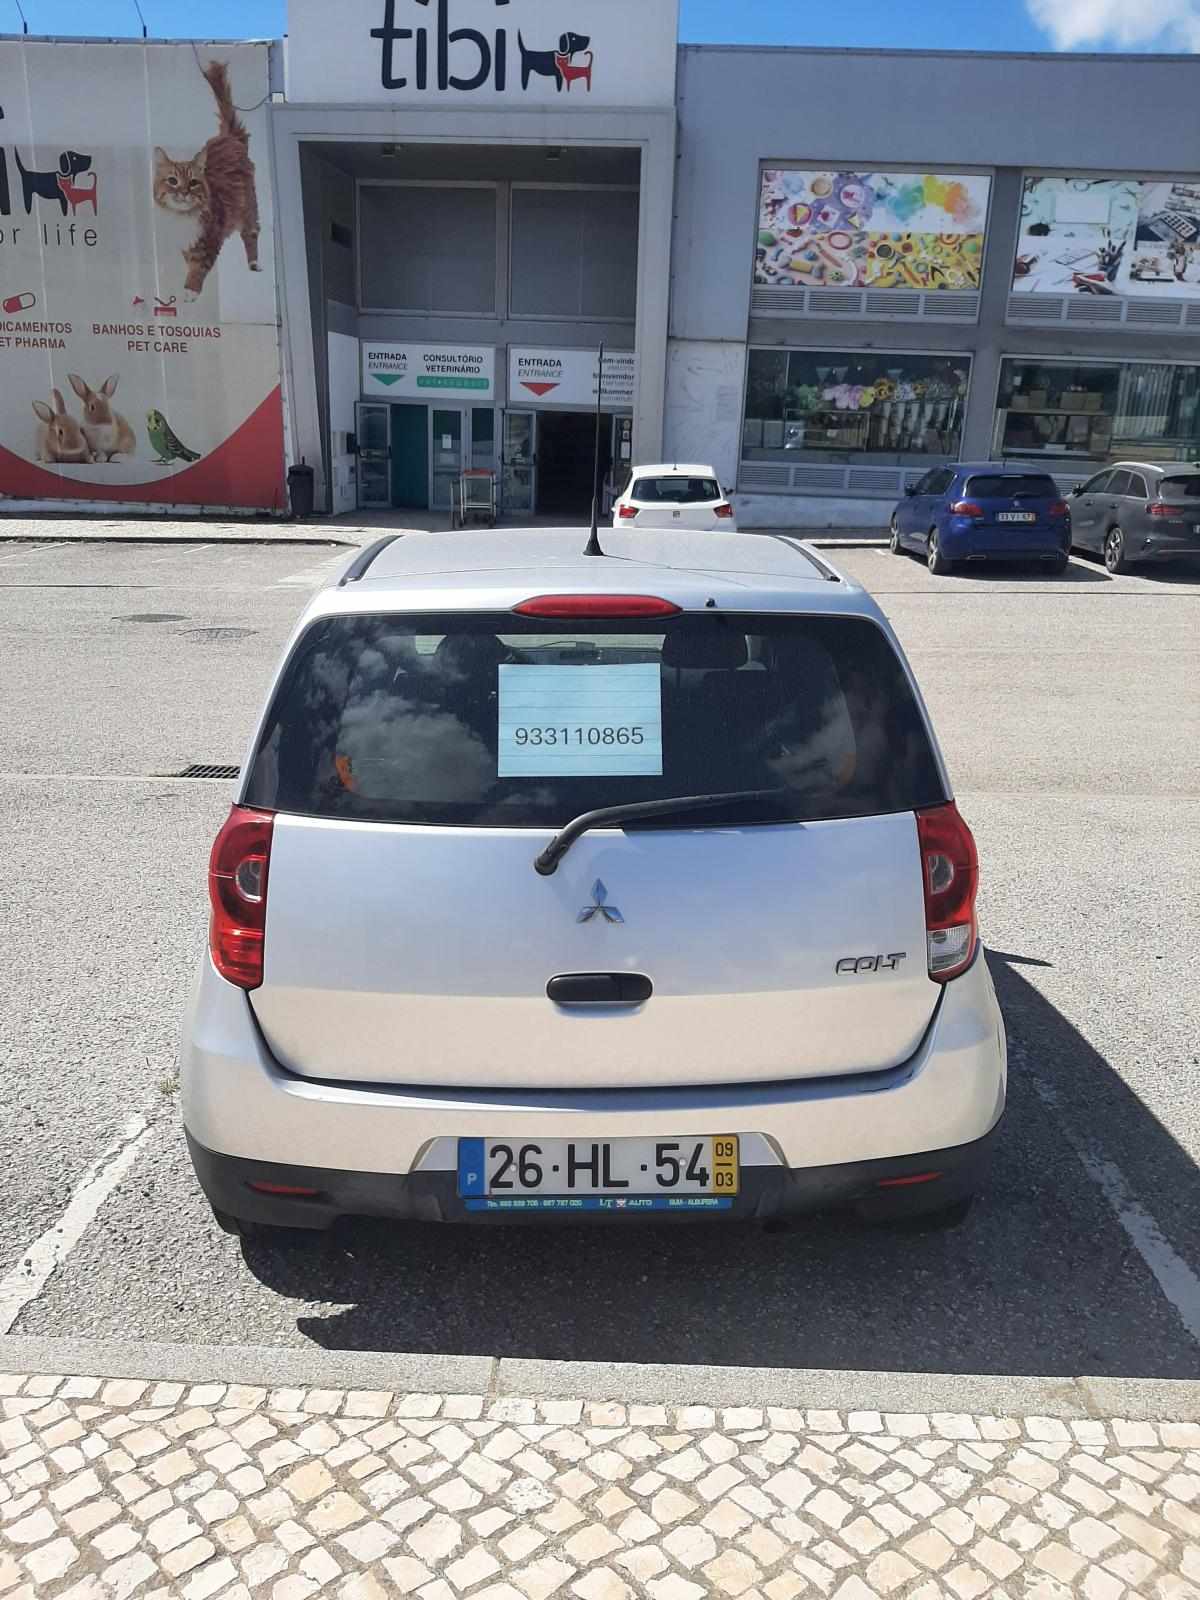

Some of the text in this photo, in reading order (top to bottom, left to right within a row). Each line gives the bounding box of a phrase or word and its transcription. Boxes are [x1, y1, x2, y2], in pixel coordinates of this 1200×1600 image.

[370, 0, 510, 91] tibi
[43, 223, 98, 247] life
[0, 321, 73, 334] ICAMENTOS
[92, 323, 222, 338] BANHOS E TOSQUIAS
[15, 337, 67, 349] PHARMA
[127, 340, 189, 353] PET CARE
[368, 352, 408, 361] ENTRADA
[423, 353, 484, 364] CONSULTÓRIO
[518, 358, 562, 368] ENTRADA
[425, 363, 481, 374] VETERINÁRIO
[515, 727, 644, 746] 933110865
[835, 952, 907, 975] COLT
[715, 1142, 734, 1157] 09
[466, 1172, 478, 1185] P
[715, 1172, 734, 1187] 03
